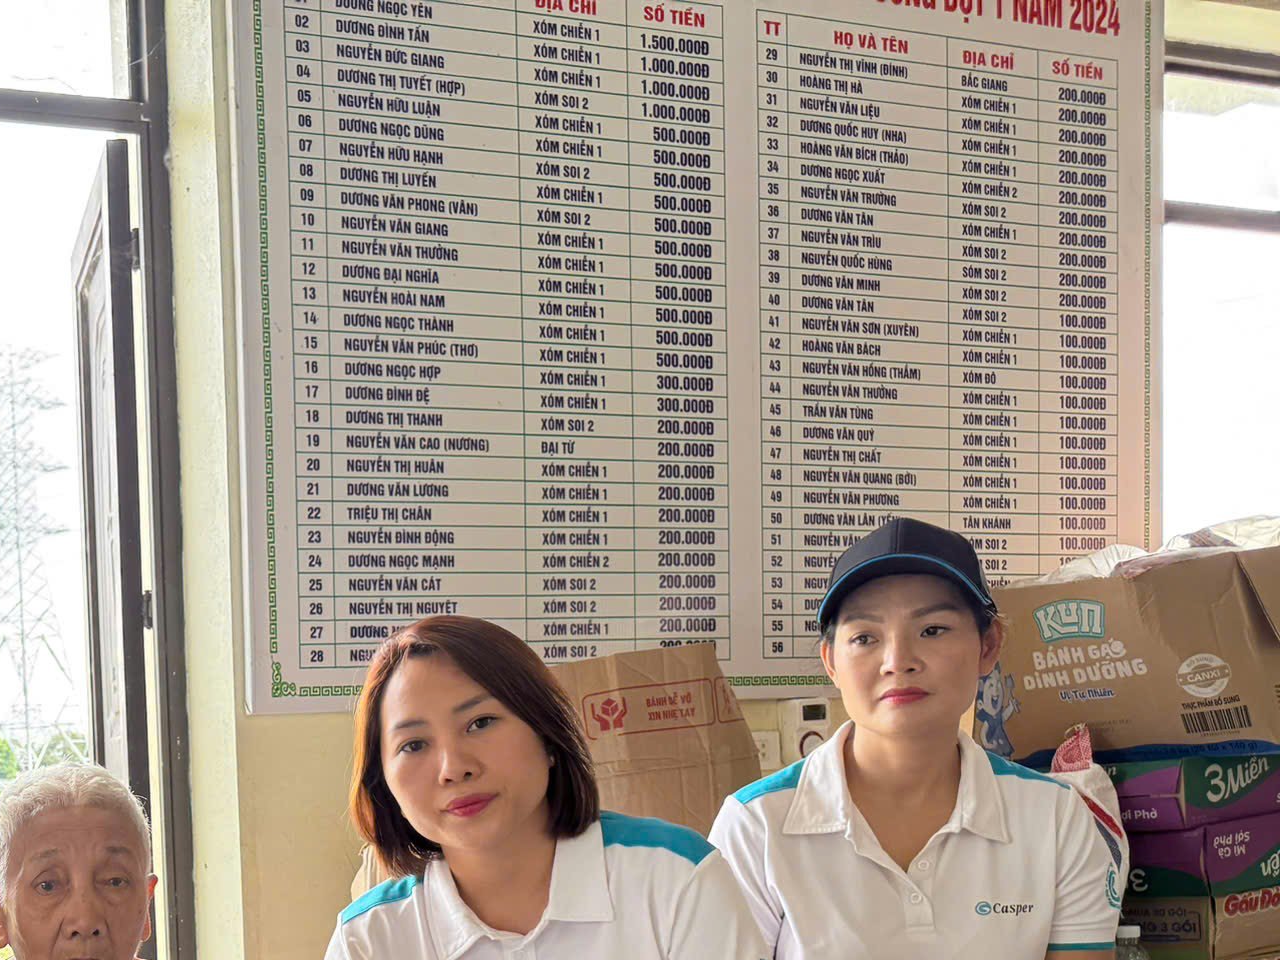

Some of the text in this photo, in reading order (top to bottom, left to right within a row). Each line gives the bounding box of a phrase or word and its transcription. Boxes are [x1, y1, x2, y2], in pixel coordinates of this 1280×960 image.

[644, 2, 704, 27] SỐ TIỀN
[1069, 0, 1121, 37] 2024
[294, 14, 309, 29] 02
[335, 19, 375, 37] DƯƠNG
[377, 22, 405, 40] ĐÌNH
[407, 25, 429, 43] TẤN
[533, 42, 558, 59] XÓM
[595, 52, 600, 65] 1
[640, 56, 710, 78] 1.000.000Đ
[764, 20, 1102, 80] TT HỌ VÀ TÊN ĐỊA CHỈ SỐ TIỀN
[765, 47, 778, 61] 29
[799, 51, 837, 69] NGUYỄN
[839, 57, 853, 74] THỊ
[961, 71, 979, 88] BẮC
[981, 77, 1008, 92] GIANG
[1058, 87, 1106, 106] 200.000Đ
[296, 64, 311, 78] 04
[337, 68, 376, 86] DƯƠNG
[378, 73, 396, 91] THỊ
[398, 74, 432, 92] TUYẾT
[534, 90, 559, 107] XÓM
[561, 94, 579, 109] SOI
[581, 97, 589, 110] 2
[641, 102, 710, 124] 1.000.000Đ
[766, 115, 779, 128] 32
[799, 119, 832, 135] DƯƠNG
[834, 121, 859, 138] QUỐC
[861, 126, 879, 140] HUY
[961, 137, 982, 153] XÓM
[1012, 144, 1016, 156] 1
[1058, 149, 1107, 167] 200.000Đ
[300, 188, 314, 202] 09
[340, 191, 379, 207] DƯƠNG
[382, 193, 404, 210] VĂN
[407, 197, 445, 213] PHONG
[536, 207, 561, 224] XÓM
[563, 211, 581, 225] SOI
[583, 213, 591, 226] 2
[654, 217, 712, 236] 500.000Đ
[768, 271, 1107, 310] 39 DƯƠNG VĂN MINH XÓM SOI 2 200.000Đ
[305, 409, 714, 436] 18 DƯƠNG THỊ THANH XÓM SOI 2 200.000Đ
[770, 490, 782, 502] 49
[803, 488, 840, 504] NGUYỄN
[842, 491, 861, 505] VĂN
[862, 493, 900, 506] PHƯƠNG
[962, 495, 983, 508] XÓM
[1013, 498, 1017, 509] 1
[1059, 496, 1106, 511] 100.000Đ
[308, 554, 322, 567] 24
[348, 553, 386, 568] DƯƠNG
[388, 554, 419, 570] NGỌC
[422, 554, 455, 570] MẠNH
[542, 553, 567, 568] XÓM
[602, 555, 609, 568] 2
[657, 552, 716, 567] 200.000Đ
[1032, 646, 1086, 671] BÁNH
[1072, 658, 1148, 684] DƯỠNG
[1187, 669, 1221, 682] CANXI
[992, 902, 1034, 916] Casper
[1224, 892, 1259, 917] Gấu
